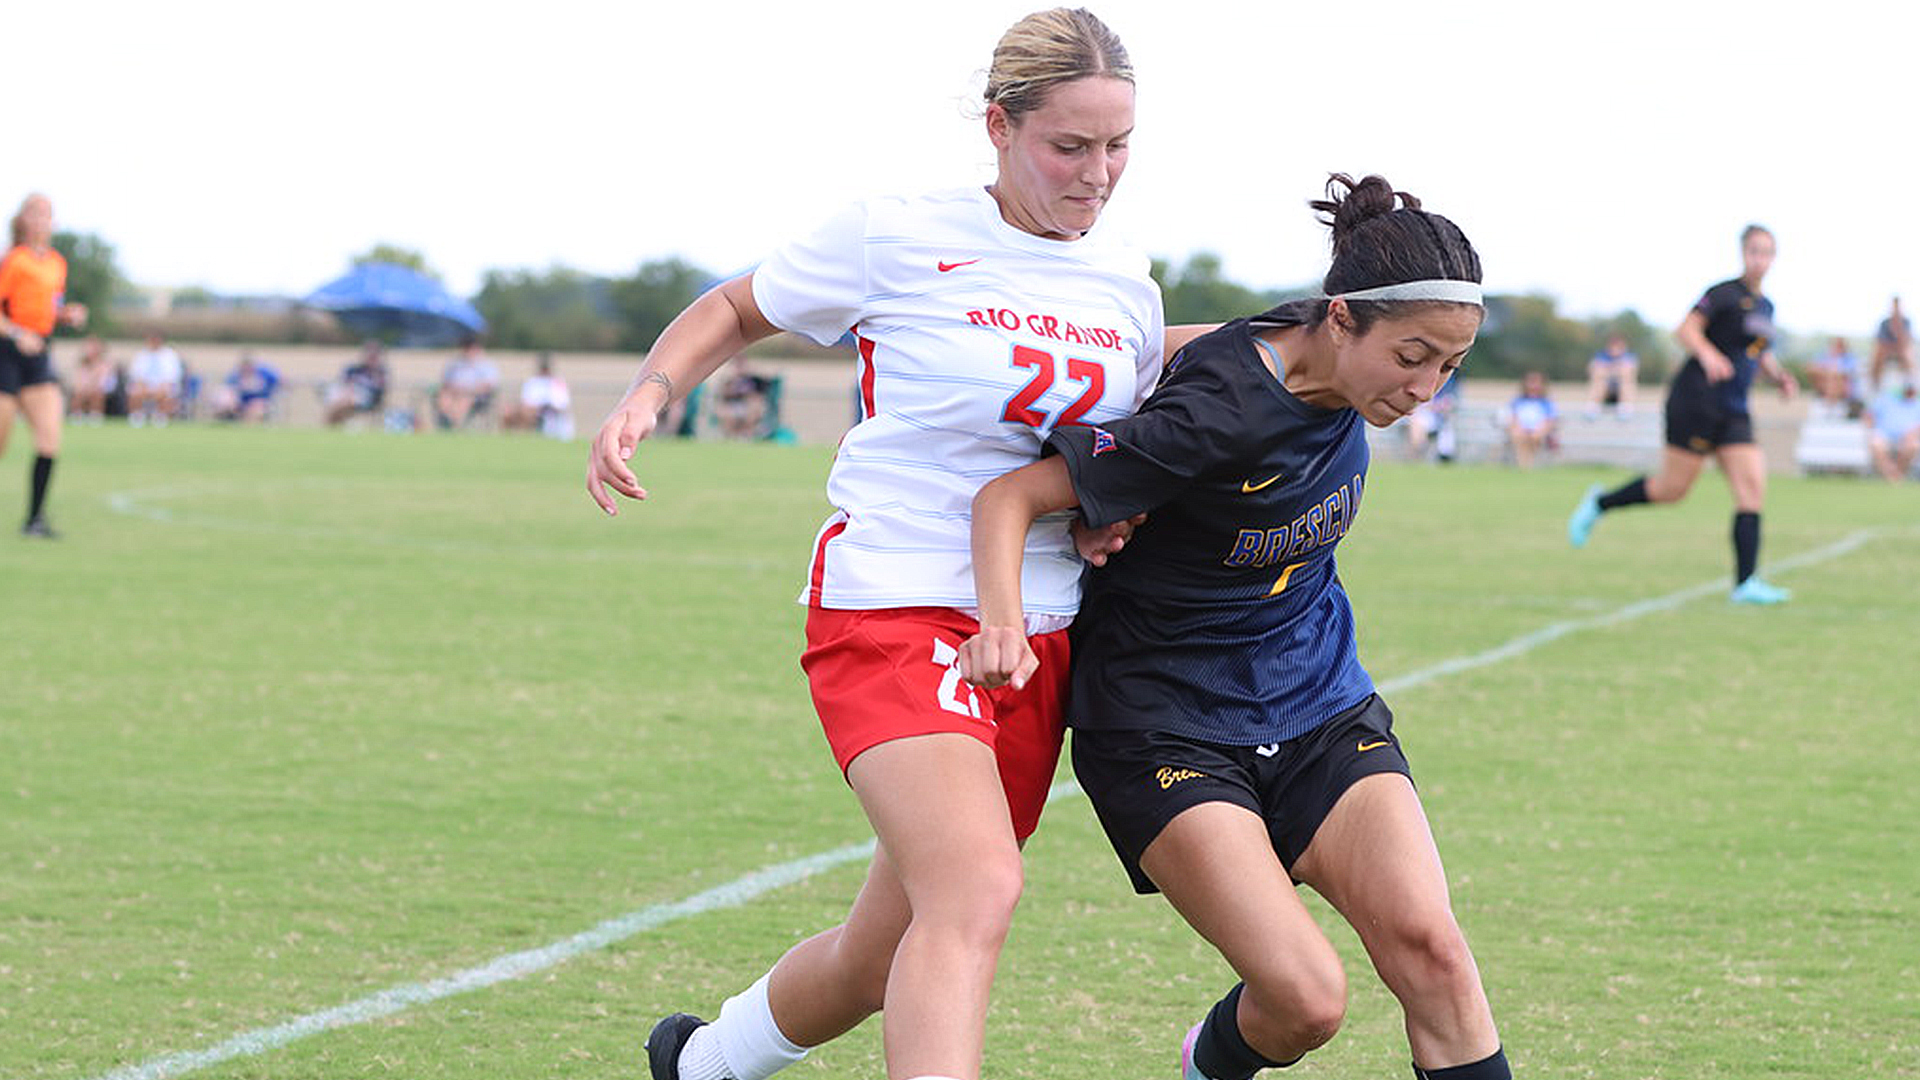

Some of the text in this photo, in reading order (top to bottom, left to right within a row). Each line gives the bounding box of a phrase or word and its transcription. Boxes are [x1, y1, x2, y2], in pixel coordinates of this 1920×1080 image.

[966, 308, 1123, 351] RIO GRANDE
[1000, 342, 1106, 435] 22
